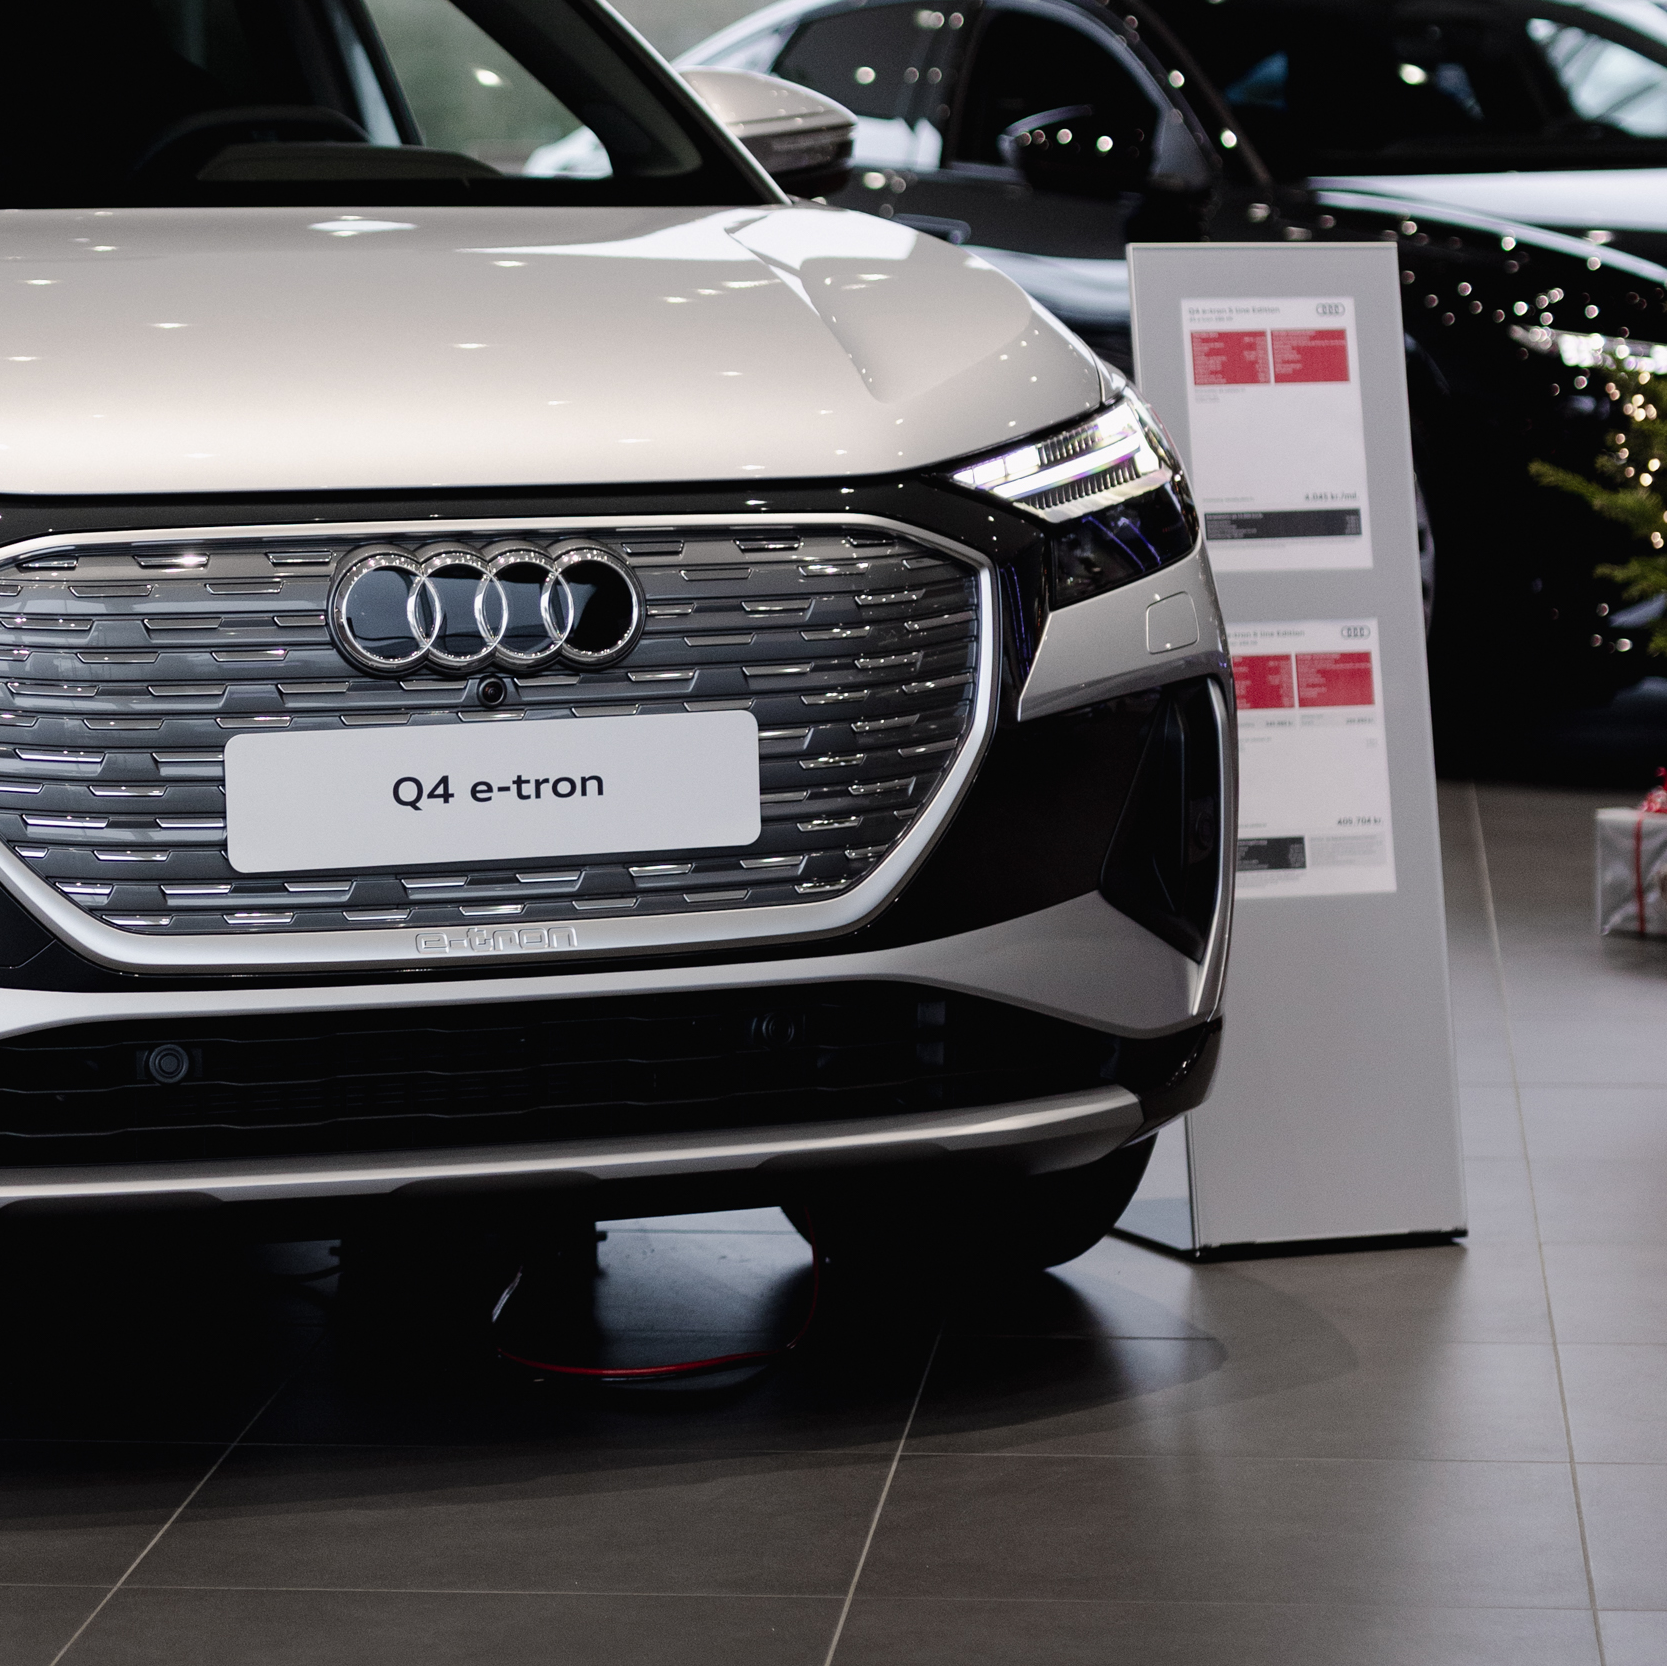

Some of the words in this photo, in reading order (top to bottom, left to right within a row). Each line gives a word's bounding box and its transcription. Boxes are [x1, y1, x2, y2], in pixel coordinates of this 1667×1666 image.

[392, 774, 455, 812] Q4
[470, 774, 604, 803] e-tron
[415, 926, 578, 955] e-tron
